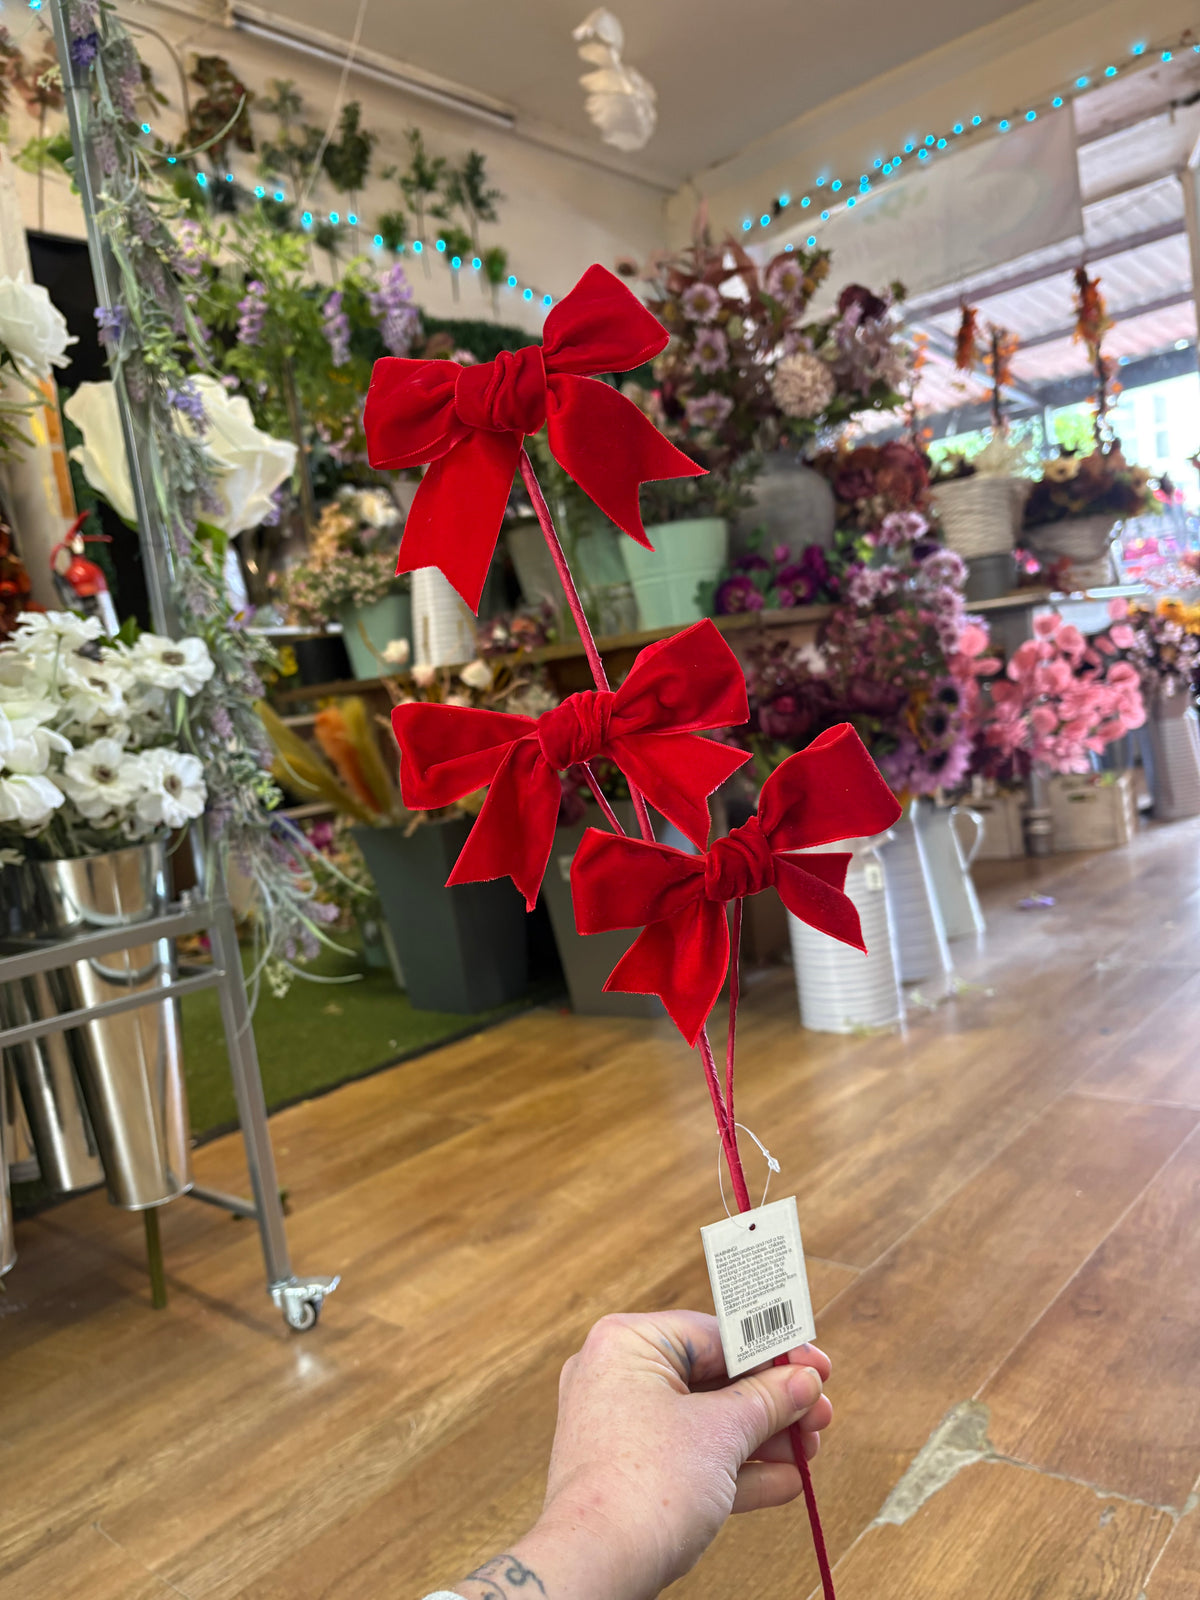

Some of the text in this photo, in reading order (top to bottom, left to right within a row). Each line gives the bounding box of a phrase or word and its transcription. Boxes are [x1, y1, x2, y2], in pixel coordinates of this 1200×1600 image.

[716, 1261, 728, 1269] Keep
[718, 1272, 728, 1280] and
[728, 1268, 738, 1276] long
[751, 1258, 764, 1267] which
[719, 1274, 737, 1285] choking
[730, 1276, 747, 1286] contain
[748, 1271, 759, 1279] sharp
[751, 1281, 774, 1295] packaging
[774, 1277, 786, 1285] away
[787, 1272, 797, 1280] from
[721, 1287, 733, 1296] hang
[722, 1292, 734, 1301] Keep
[735, 1288, 746, 1296] away
[724, 1300, 741, 1311] children
[725, 1306, 741, 1316] correct
[746, 1302, 768, 1316] PRODUCT
[747, 1334, 770, 1349] 013206
[771, 1323, 794, 1338] 511398
[756, 1342, 775, 1355] PRODUCTS
